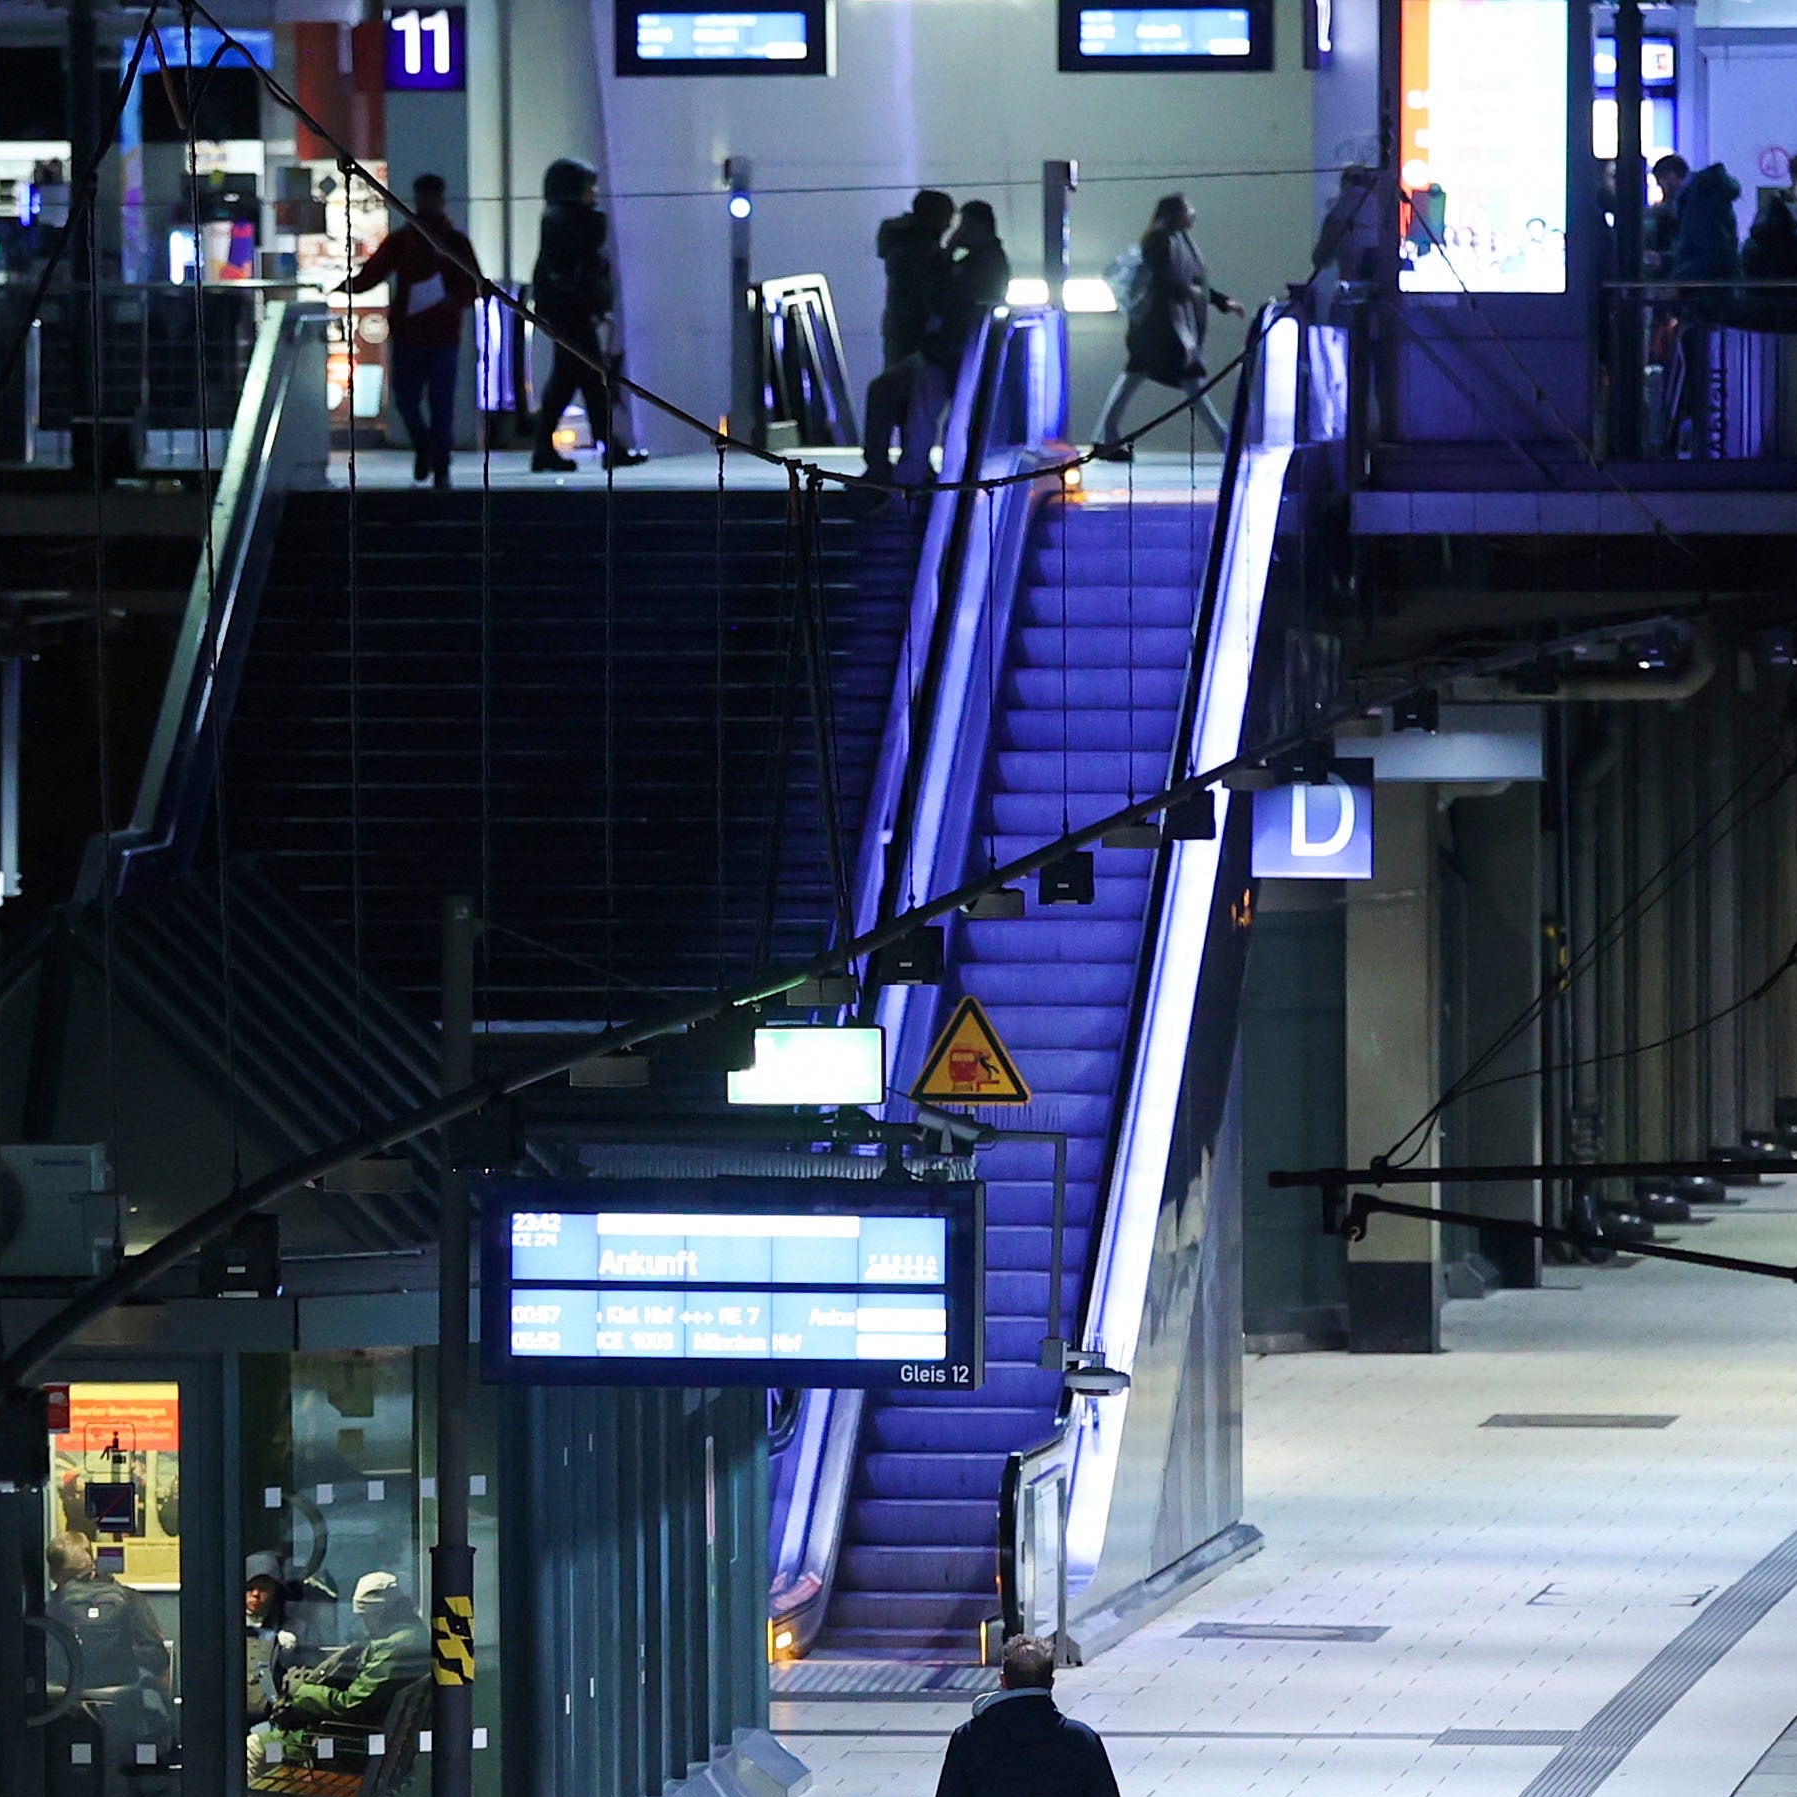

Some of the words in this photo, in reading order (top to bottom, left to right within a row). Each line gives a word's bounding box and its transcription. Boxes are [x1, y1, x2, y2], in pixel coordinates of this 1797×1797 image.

[391, 9, 451, 75] 11
[1290, 772, 1356, 857] D
[599, 1249, 698, 1276] Ankunft
[899, 1365, 946, 1384] Gleis
[951, 1365, 970, 1383] 12
